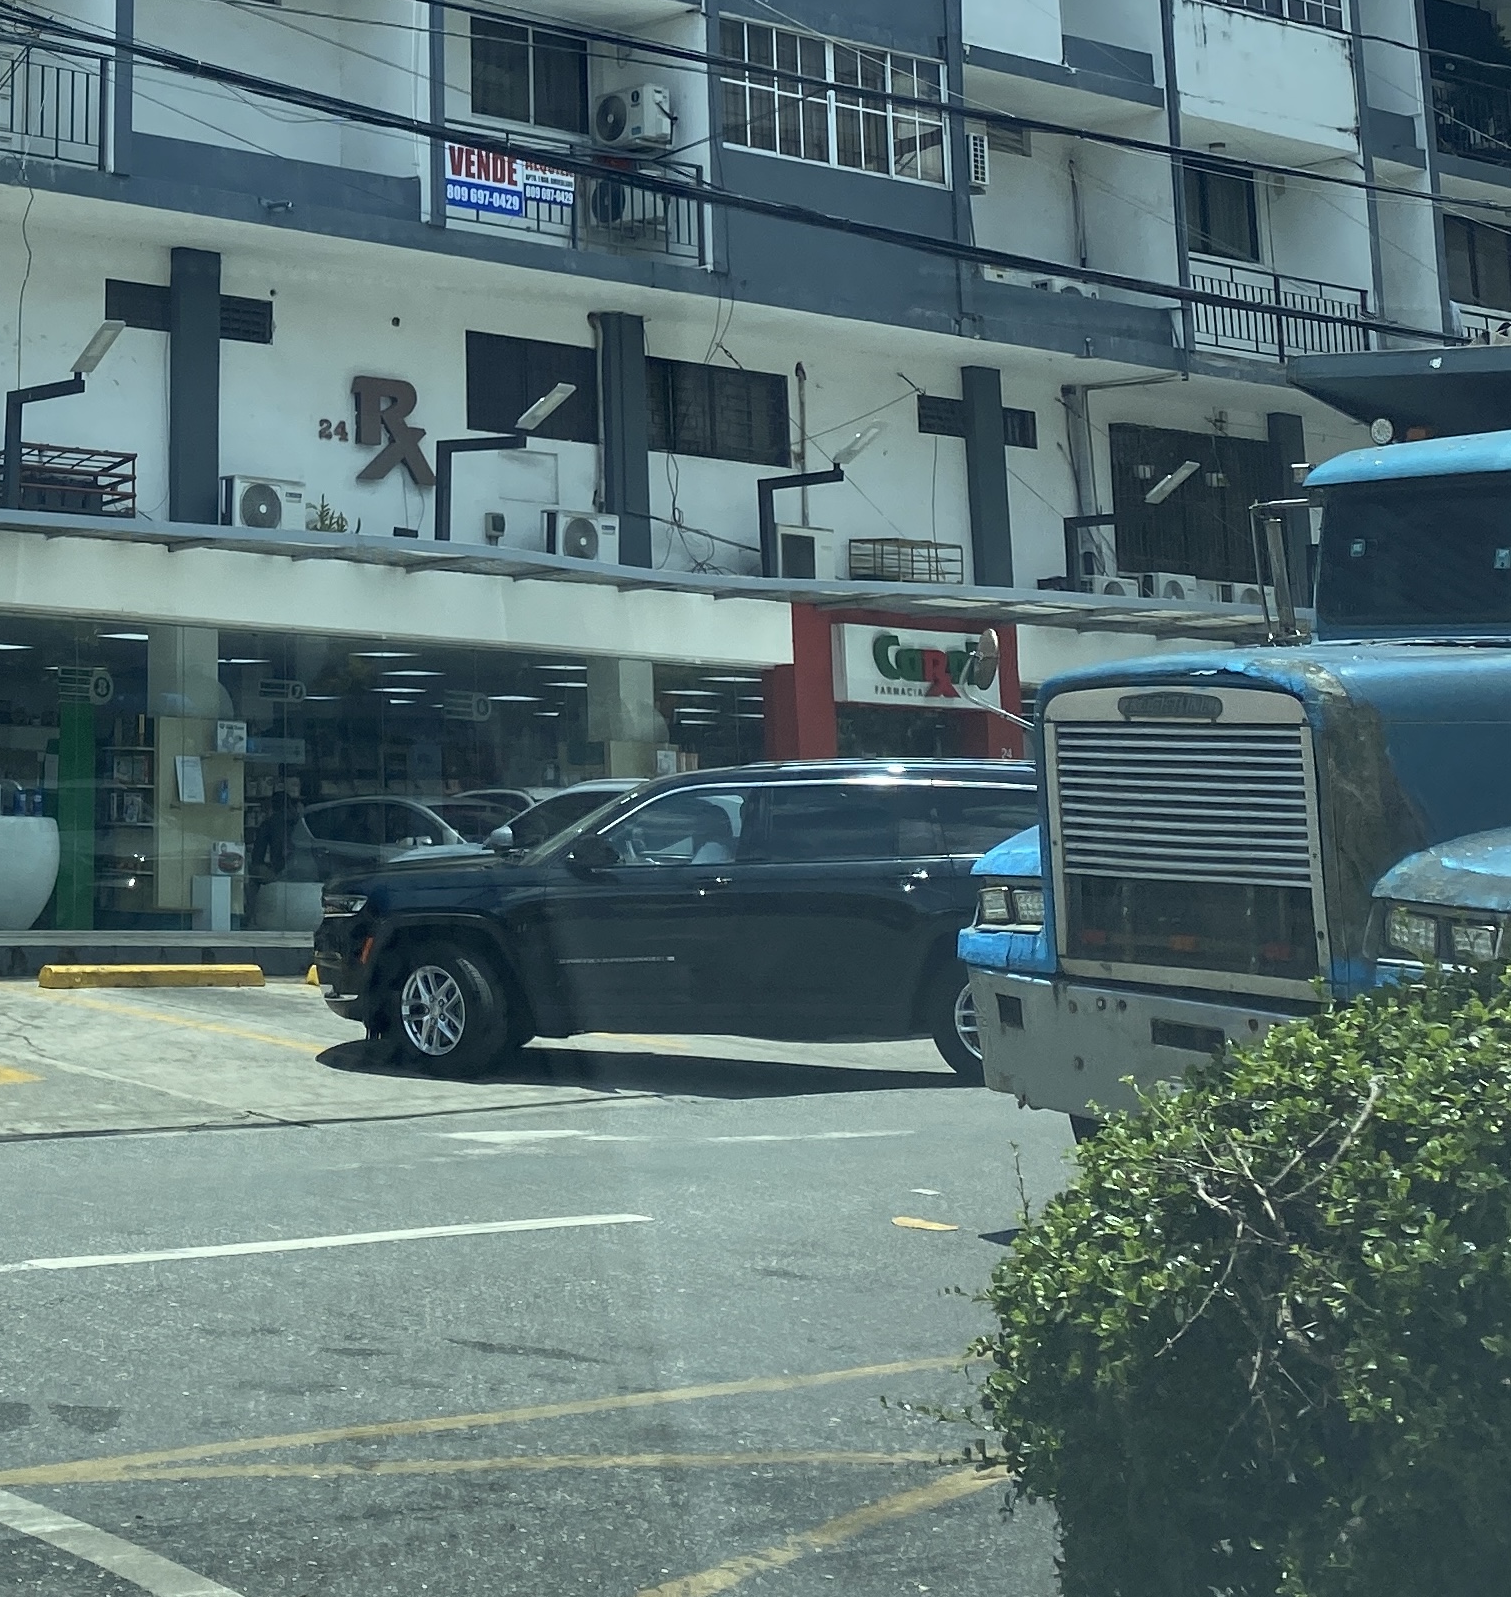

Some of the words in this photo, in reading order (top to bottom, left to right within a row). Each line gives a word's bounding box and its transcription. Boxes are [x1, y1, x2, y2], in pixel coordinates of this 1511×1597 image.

[448, 145, 518, 187] VENDE
[446, 183, 469, 202] 809
[469, 187, 520, 211] 697-0429
[525, 185, 541, 199] 809
[541, 188, 574, 204] 697-0429
[318, 418, 349, 442] 24
